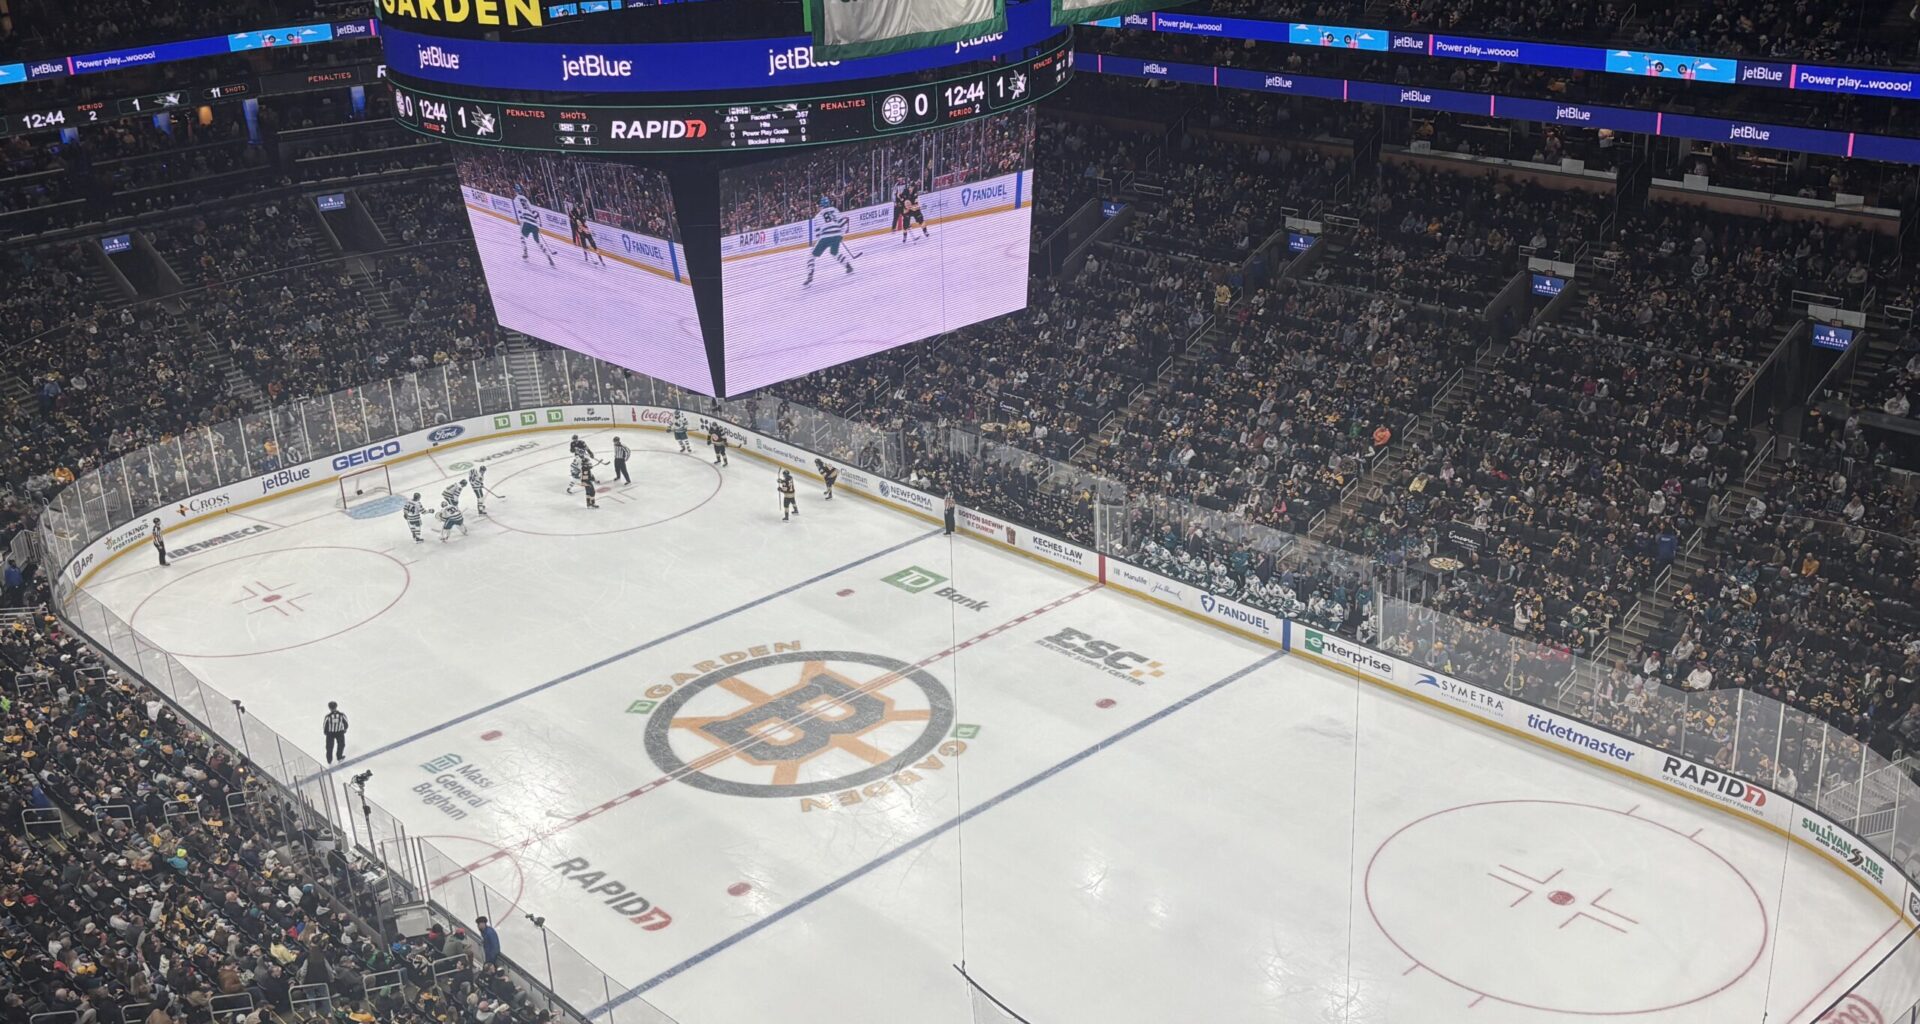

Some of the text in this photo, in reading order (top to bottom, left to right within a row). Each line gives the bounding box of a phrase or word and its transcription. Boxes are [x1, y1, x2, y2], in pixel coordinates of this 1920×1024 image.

[1124, 14, 1148, 26] jetBlue
[1158, 18, 1178, 28] Power
[336, 24, 366, 37] jetBlue
[1393, 36, 1423, 50] jetBlue
[1436, 41, 1462, 53] Power
[76, 58, 102, 69] Power
[418, 44, 459, 70] jetBlue
[768, 46, 840, 76] jetBl
[30, 61, 64, 77] jetBlue
[562, 54, 632, 81] jetBlue
[1143, 63, 1168, 76] jetBlue
[1743, 65, 1783, 82] jetBlue
[308, 72, 352, 83] PENALTIES
[996, 76, 1004, 98] 1
[1265, 75, 1292, 88] jetBlue
[1801, 72, 1912, 92] Power play...woooo!
[210, 84, 247, 98] 11 SHOTS
[944, 80, 984, 108] 12:44
[1400, 89, 1431, 104] jetBlue
[77, 102, 103, 112] PERIOD
[132, 98, 140, 112] 1
[405, 95, 414, 117] 0
[506, 108, 546, 118] PENALTIES
[820, 99, 866, 110] PENALTIES
[915, 94, 928, 116] 0
[949, 103, 981, 118] PERIOD 2
[1556, 105, 1591, 120] jetBlue
[22, 111, 66, 130] 12:44
[89, 111, 98, 122] 2
[458, 106, 466, 128] 1
[560, 111, 587, 120] SHOTS
[610, 119, 706, 139] RAPID7
[1730, 124, 1770, 141] jetBlue
[972, 184, 1008, 201] FANDUEL
[631, 239, 664, 260] FANDUEL
[496, 416, 509, 428] TD
[522, 413, 535, 424] TD
[549, 410, 562, 421] TD
[434, 428, 457, 442] Ford
[332, 441, 400, 472] GEICO
[474, 441, 540, 462] wasabi
[262, 466, 311, 494] jetBlue
[189, 492, 230, 512] CROSS
[890, 486, 932, 507] NEWFORMA
[1033, 536, 1082, 560] KECHES LAW
[896, 570, 936, 588] TD
[934, 586, 990, 612] Bank
[1218, 604, 1270, 632] FANDUEL
[1042, 626, 1150, 670] ESC
[1305, 635, 1392, 674] enterprise
[644, 640, 801, 700] GARDEN
[1442, 680, 1504, 710] SYMETRA
[1527, 713, 1635, 762] ticketmaster
[455, 764, 494, 789] Mass
[1662, 775, 1688, 788] OFFICIAL
[1662, 756, 1766, 808] RAPID7
[436, 774, 491, 808] General
[412, 782, 468, 821] Brigham
[1802, 818, 1884, 879] SULLIVAN TIRE
[552, 856, 673, 932] RAPID7
